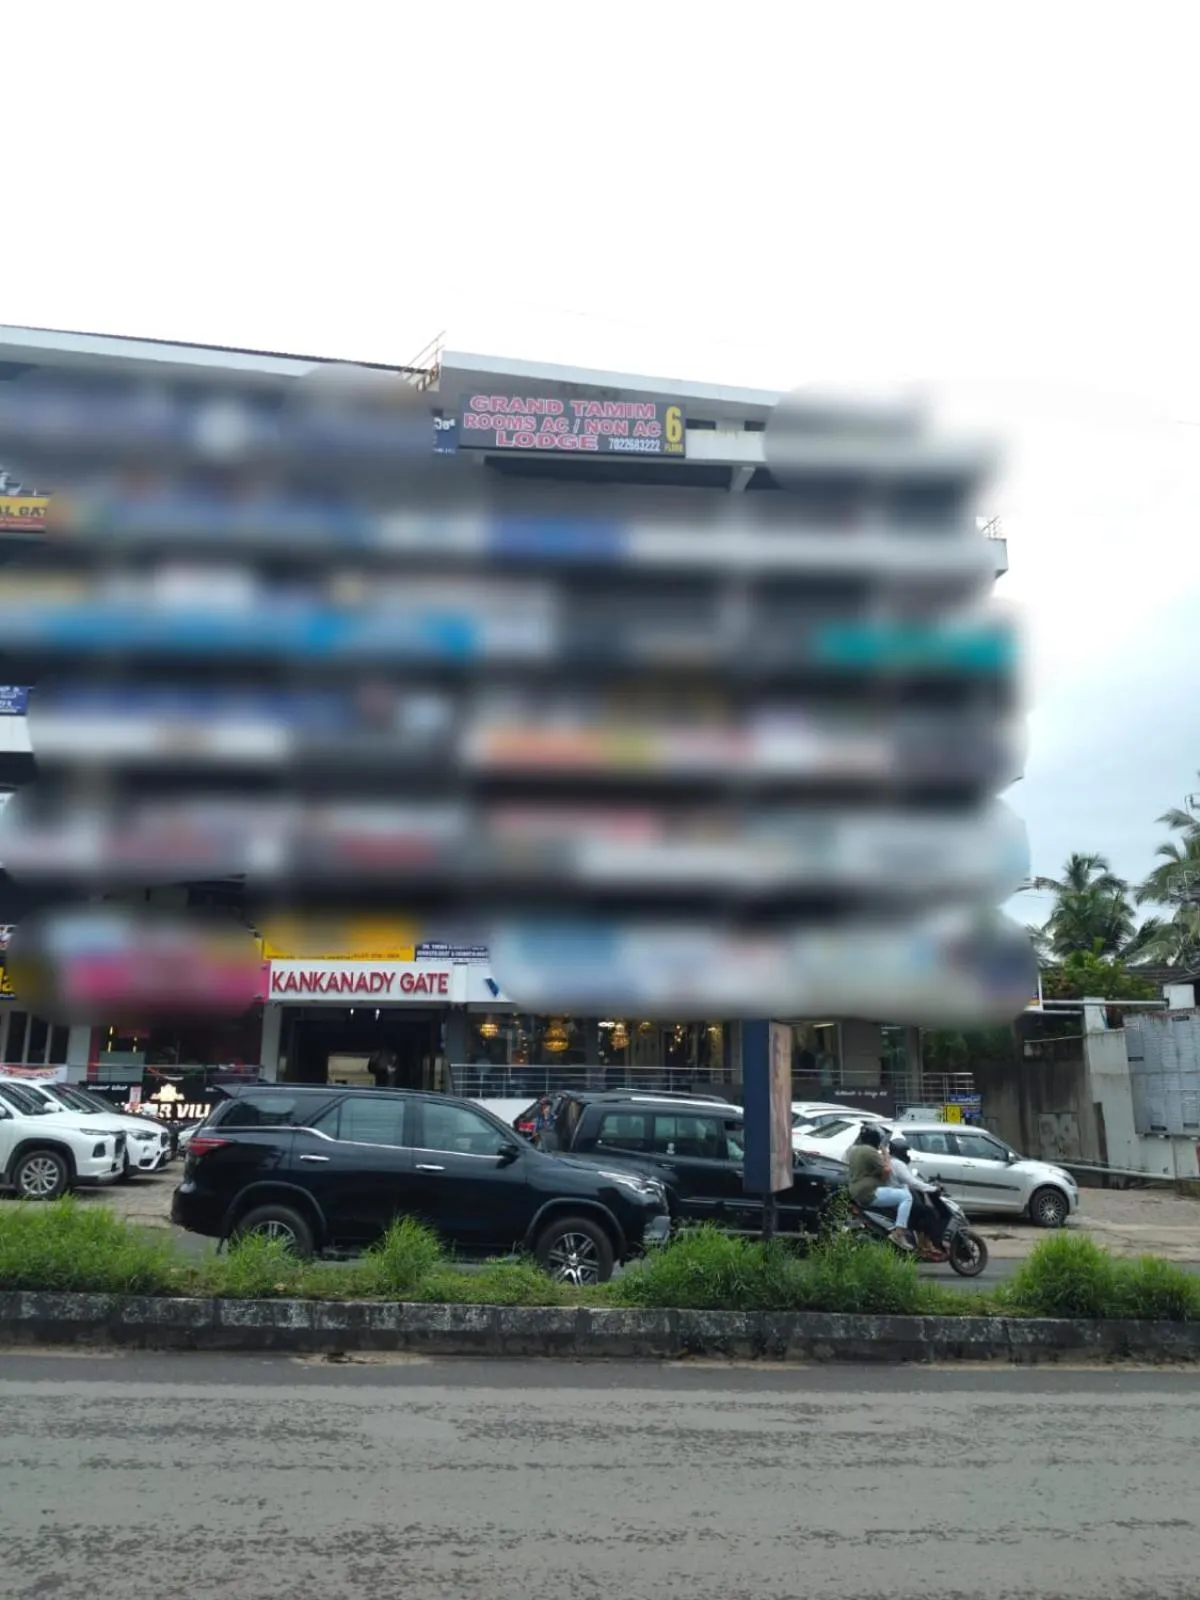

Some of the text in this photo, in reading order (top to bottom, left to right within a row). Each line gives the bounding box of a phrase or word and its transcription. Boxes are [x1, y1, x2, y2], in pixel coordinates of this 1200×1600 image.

[469, 395, 656, 420] GRAND TAMIM
[463, 412, 536, 431] ROOMS
[540, 416, 569, 433] AC
[573, 418, 581, 433] /
[583, 419, 629, 437] NON
[632, 420, 661, 437] AC
[665, 405, 683, 443] 6
[495, 430, 599, 450] LODGE
[271, 971, 450, 994] KANKANADY GATE
